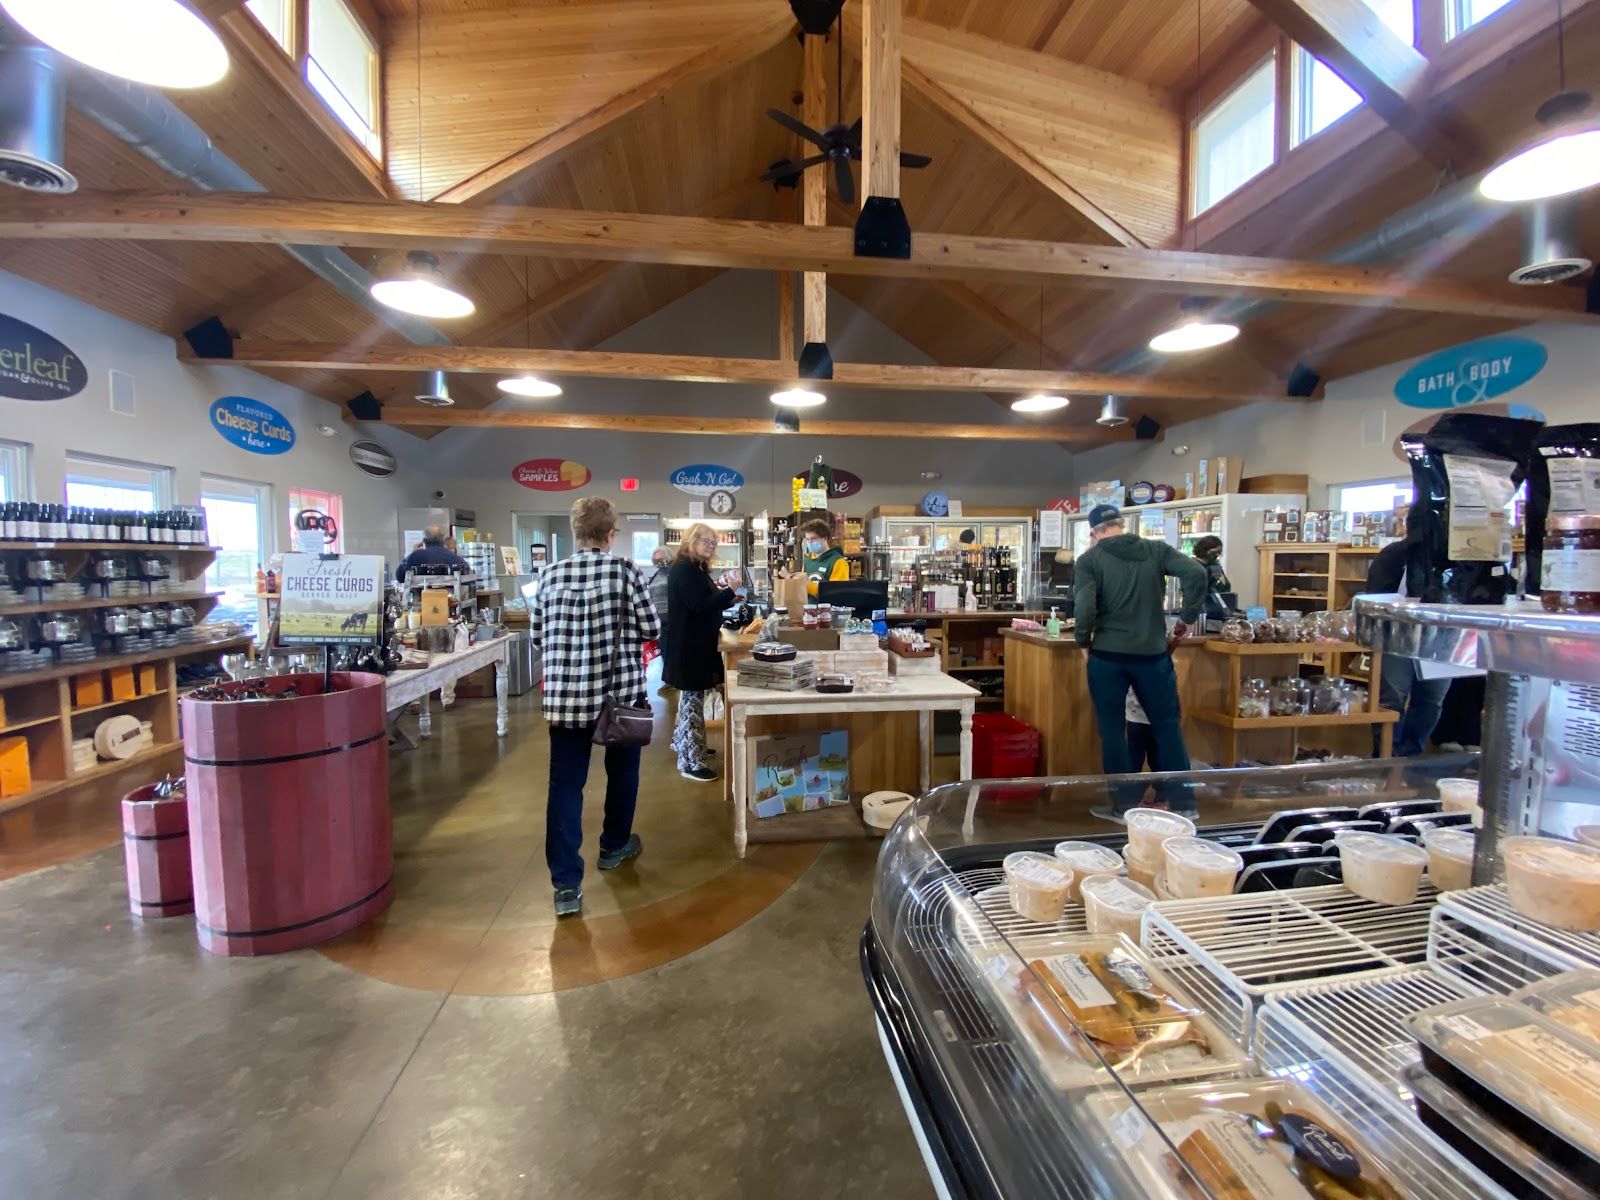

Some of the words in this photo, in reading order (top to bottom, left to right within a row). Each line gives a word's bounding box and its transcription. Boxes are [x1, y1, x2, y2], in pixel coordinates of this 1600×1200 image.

[1418, 371, 1455, 394] BATH
[1451, 356, 1488, 407] &
[1470, 356, 1513, 381] BODY
[216, 407, 258, 434] Cheese
[261, 420, 291, 442] Curds
[519, 474, 559, 483] SAMPLES
[676, 471, 701, 484] Grab
[307, 559, 352, 576] Fresh
[287, 576, 332, 592] CHEESE
[335, 577, 374, 592] CURDS
